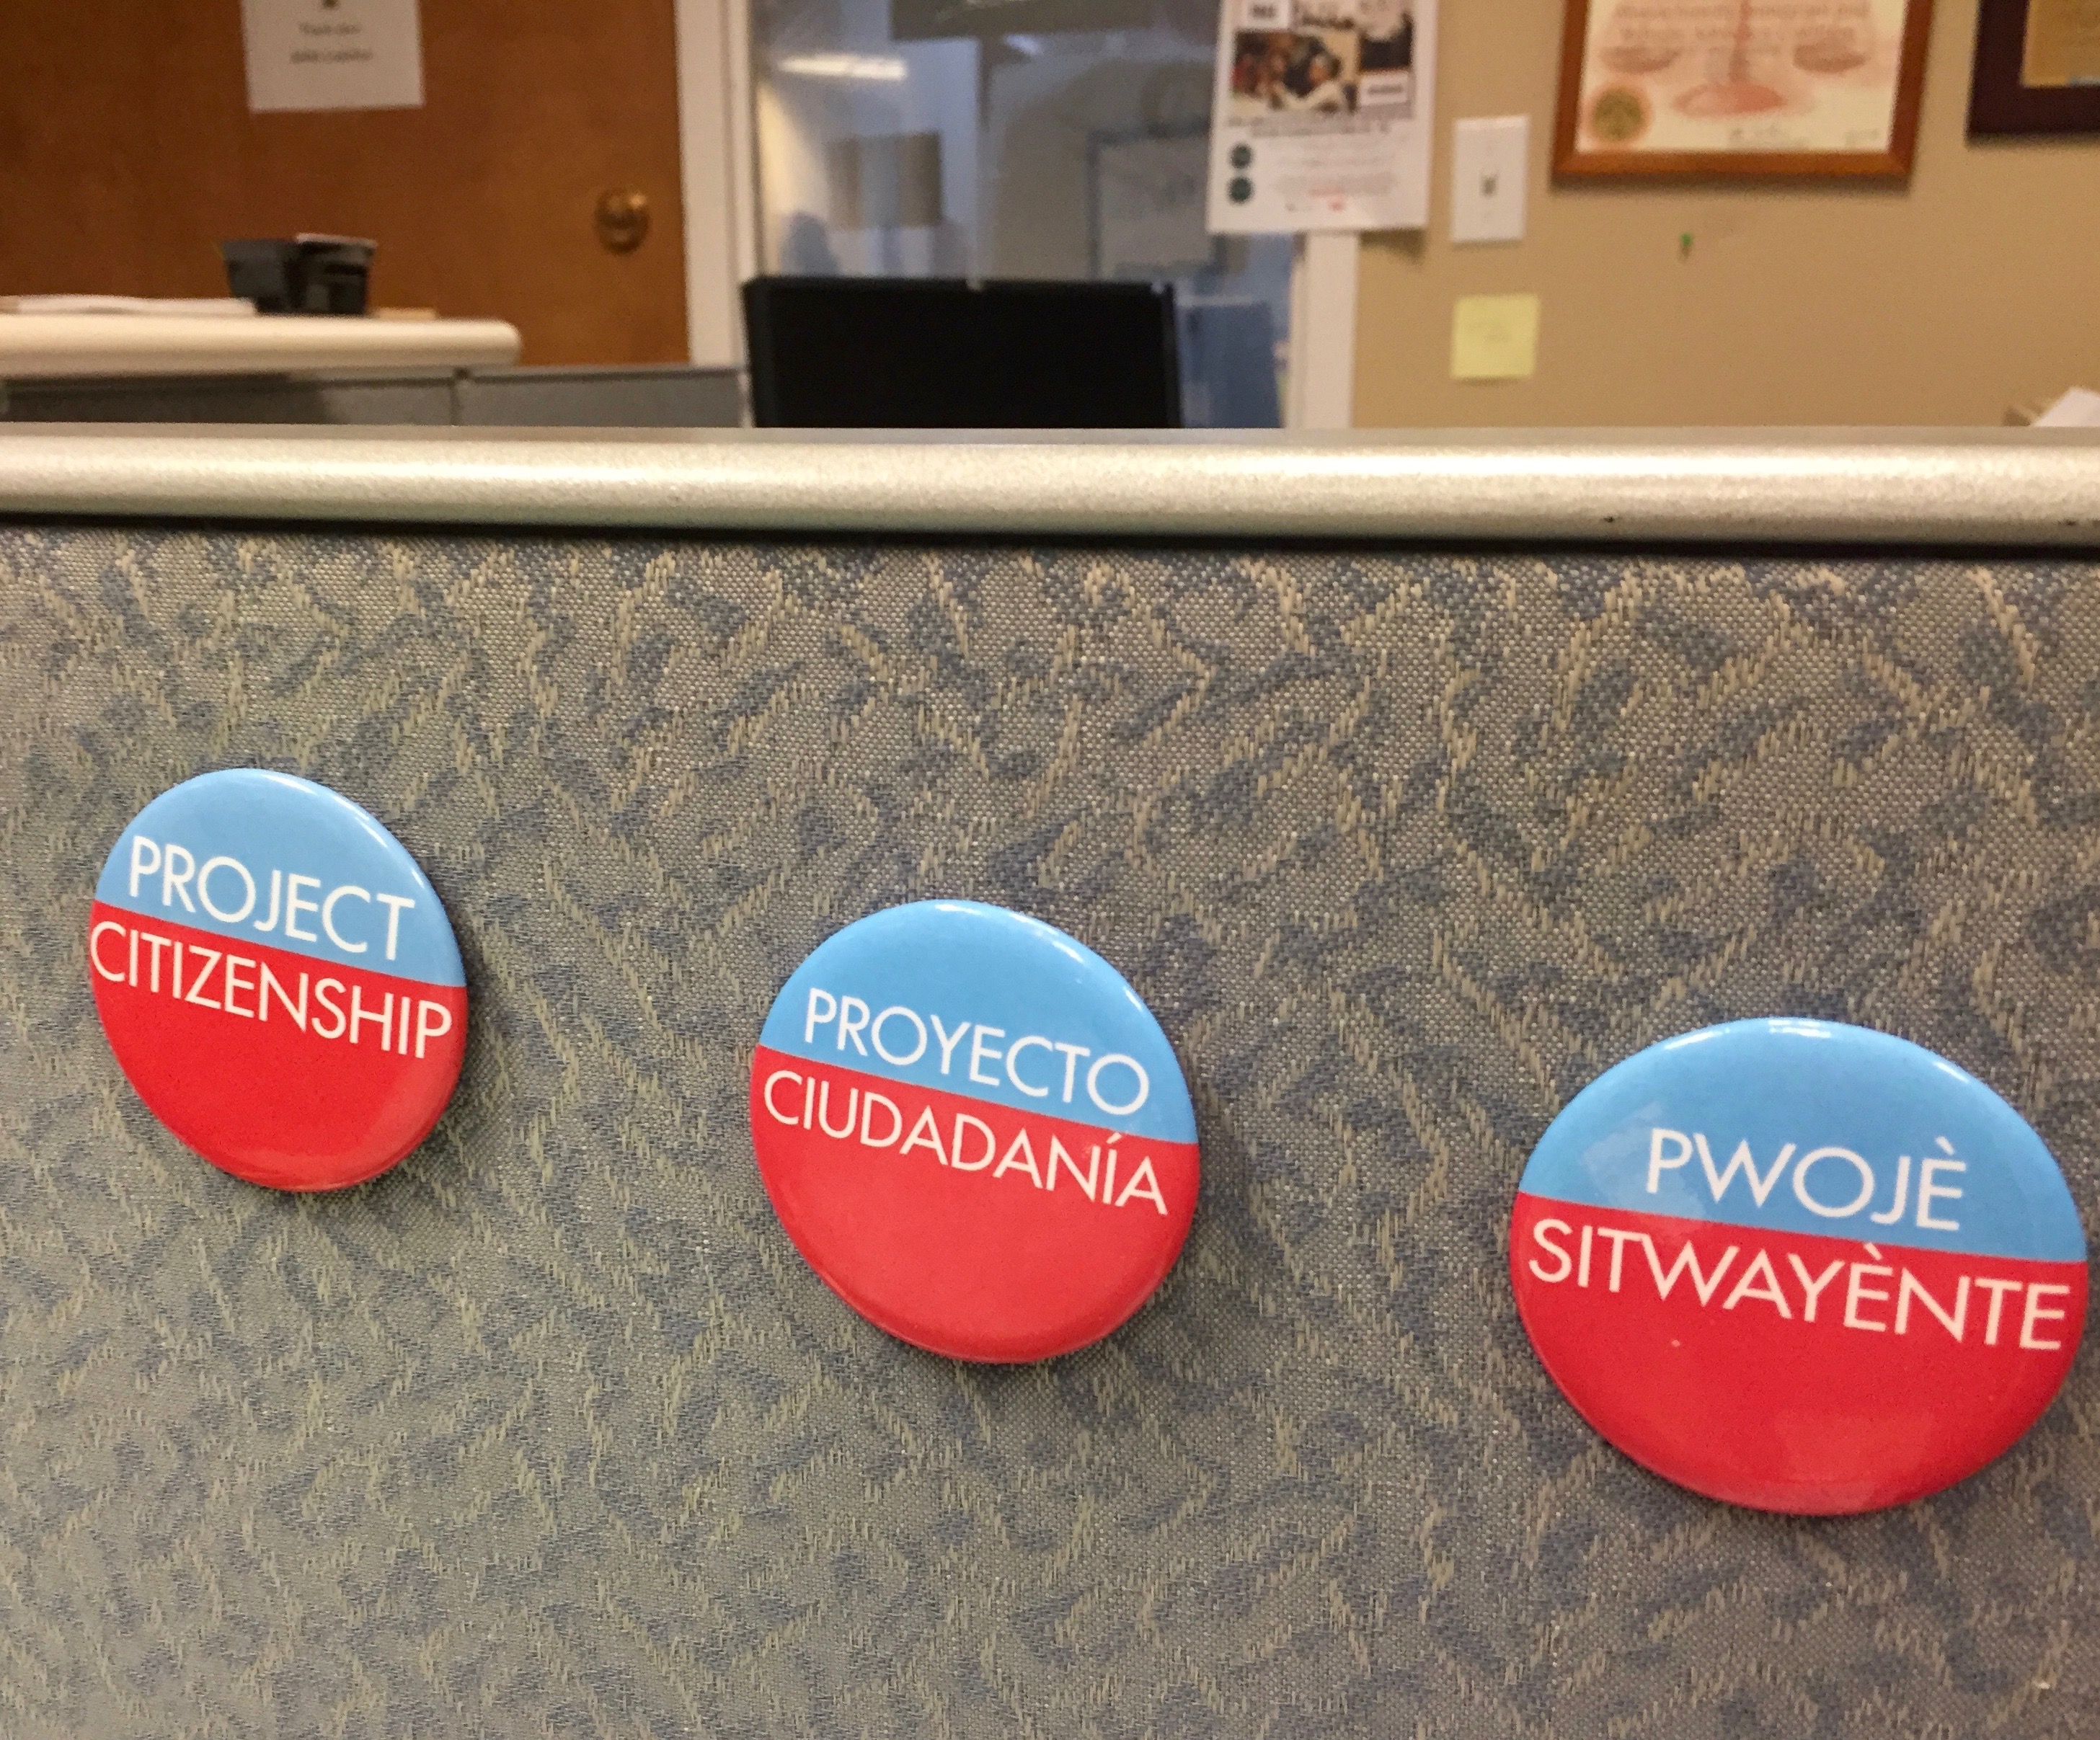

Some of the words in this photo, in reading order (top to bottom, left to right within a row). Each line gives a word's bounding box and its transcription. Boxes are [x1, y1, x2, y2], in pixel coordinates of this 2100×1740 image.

[129, 834, 415, 961] PROJECT
[89, 920, 453, 1060] CITIZENSHIP
[804, 987, 1150, 1117] PROYECTO
[763, 1070, 1168, 1216] CIUDADANÍA
[1645, 1127, 1967, 1232] PWOJÈ
[1528, 1218, 2071, 1352] SITWAYÈNTE
